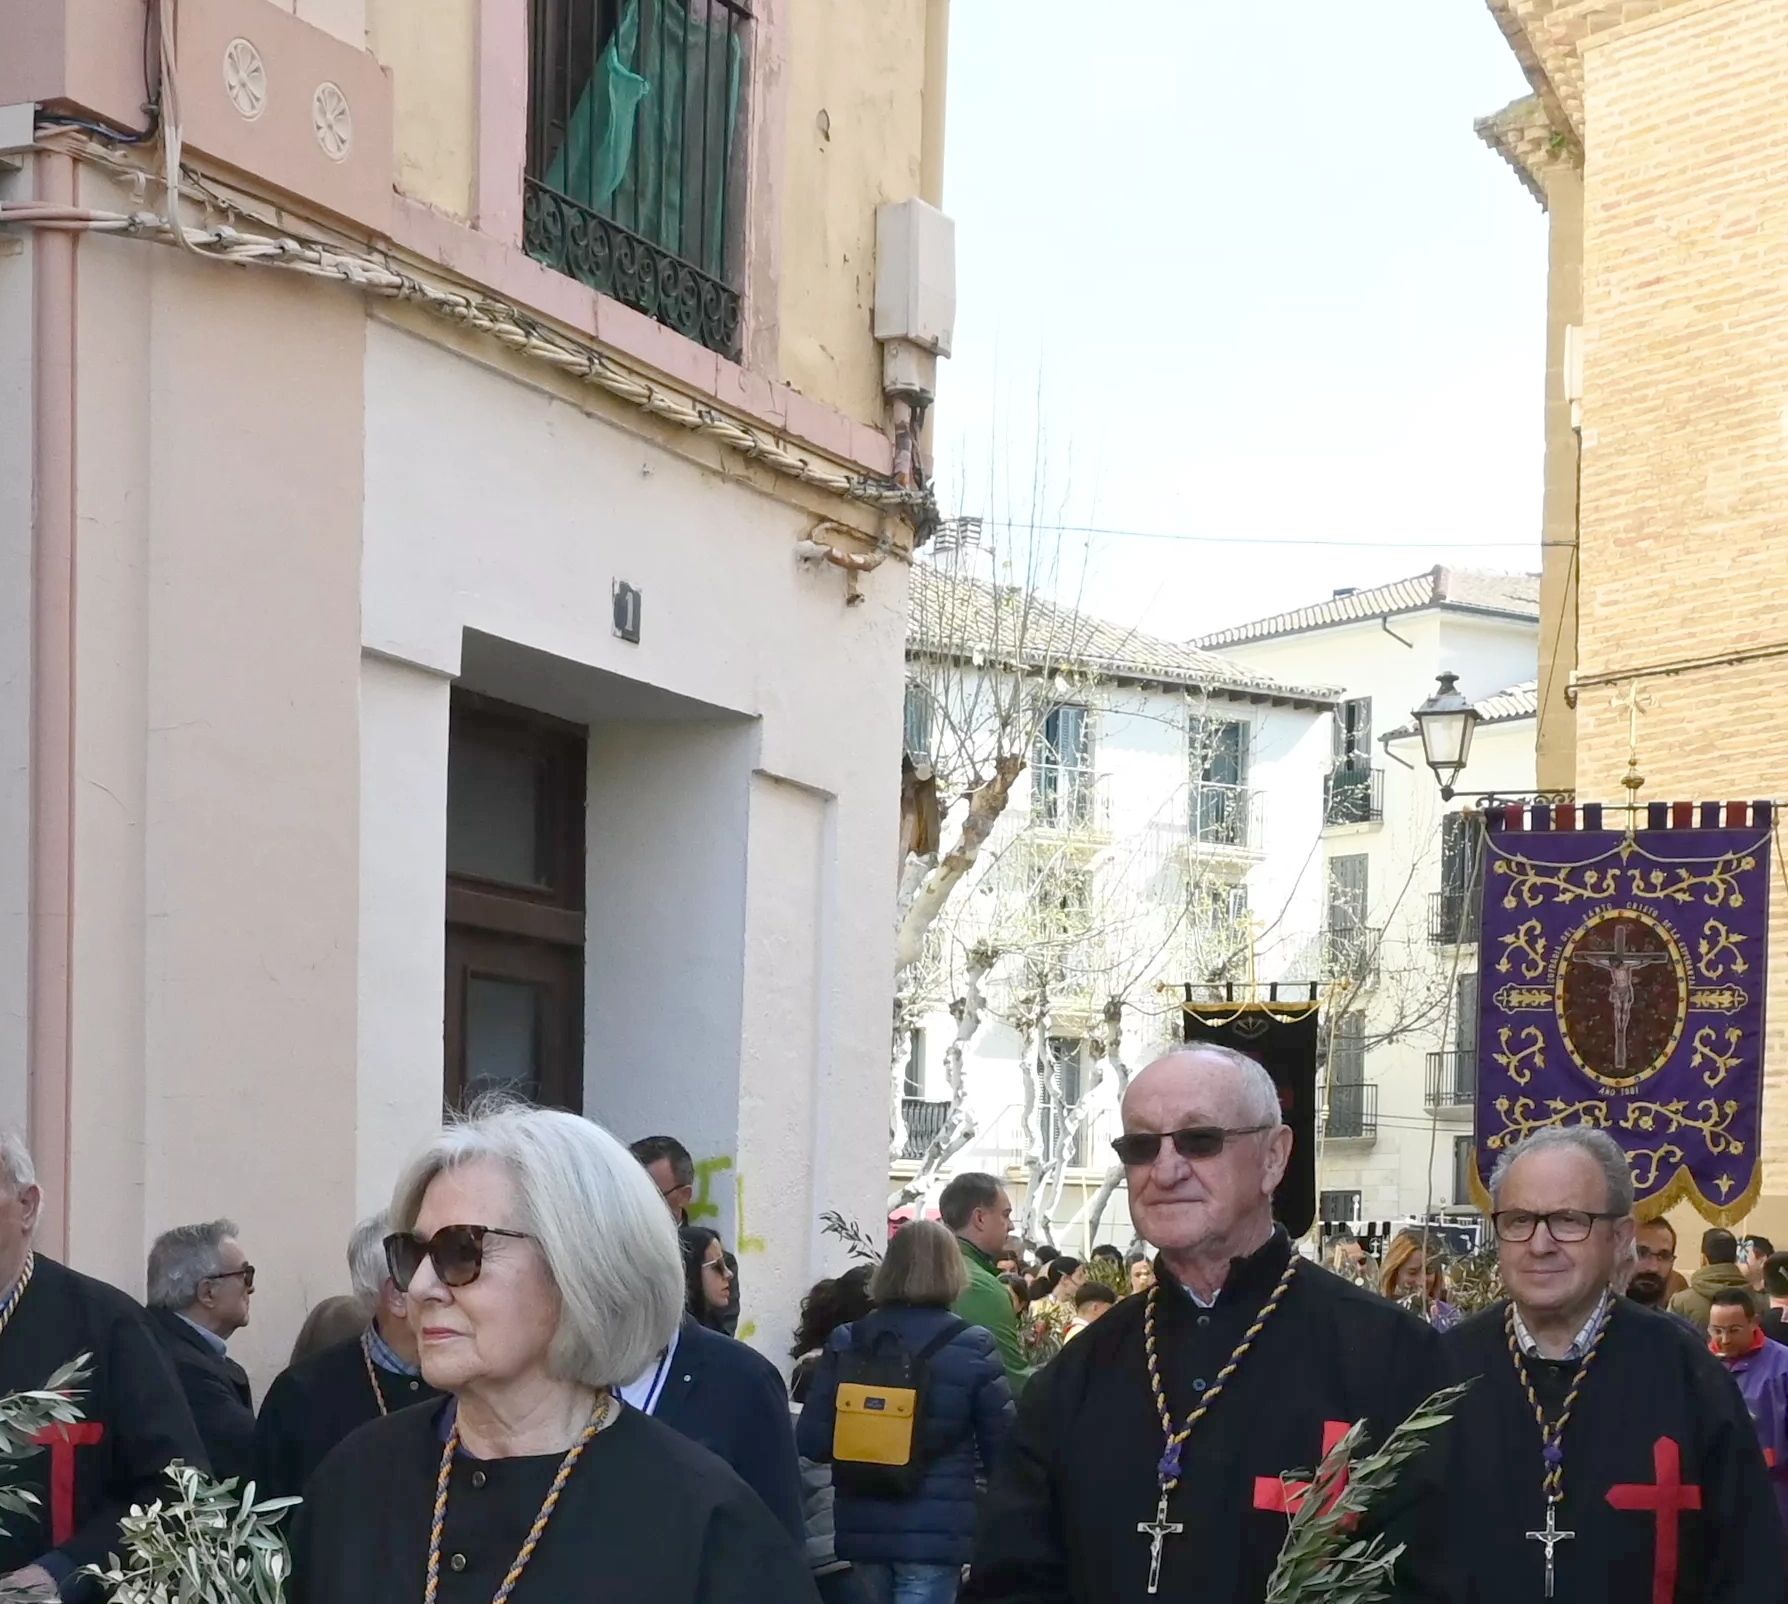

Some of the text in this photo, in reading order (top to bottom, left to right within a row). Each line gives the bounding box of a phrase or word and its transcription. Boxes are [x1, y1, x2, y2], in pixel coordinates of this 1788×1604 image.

[625, 591, 633, 631] 1
[1560, 927, 1576, 942] DEL
[1582, 903, 1612, 921] SANTO
[1626, 901, 1659, 918] CRISTO
[1670, 928, 1681, 940] LA
